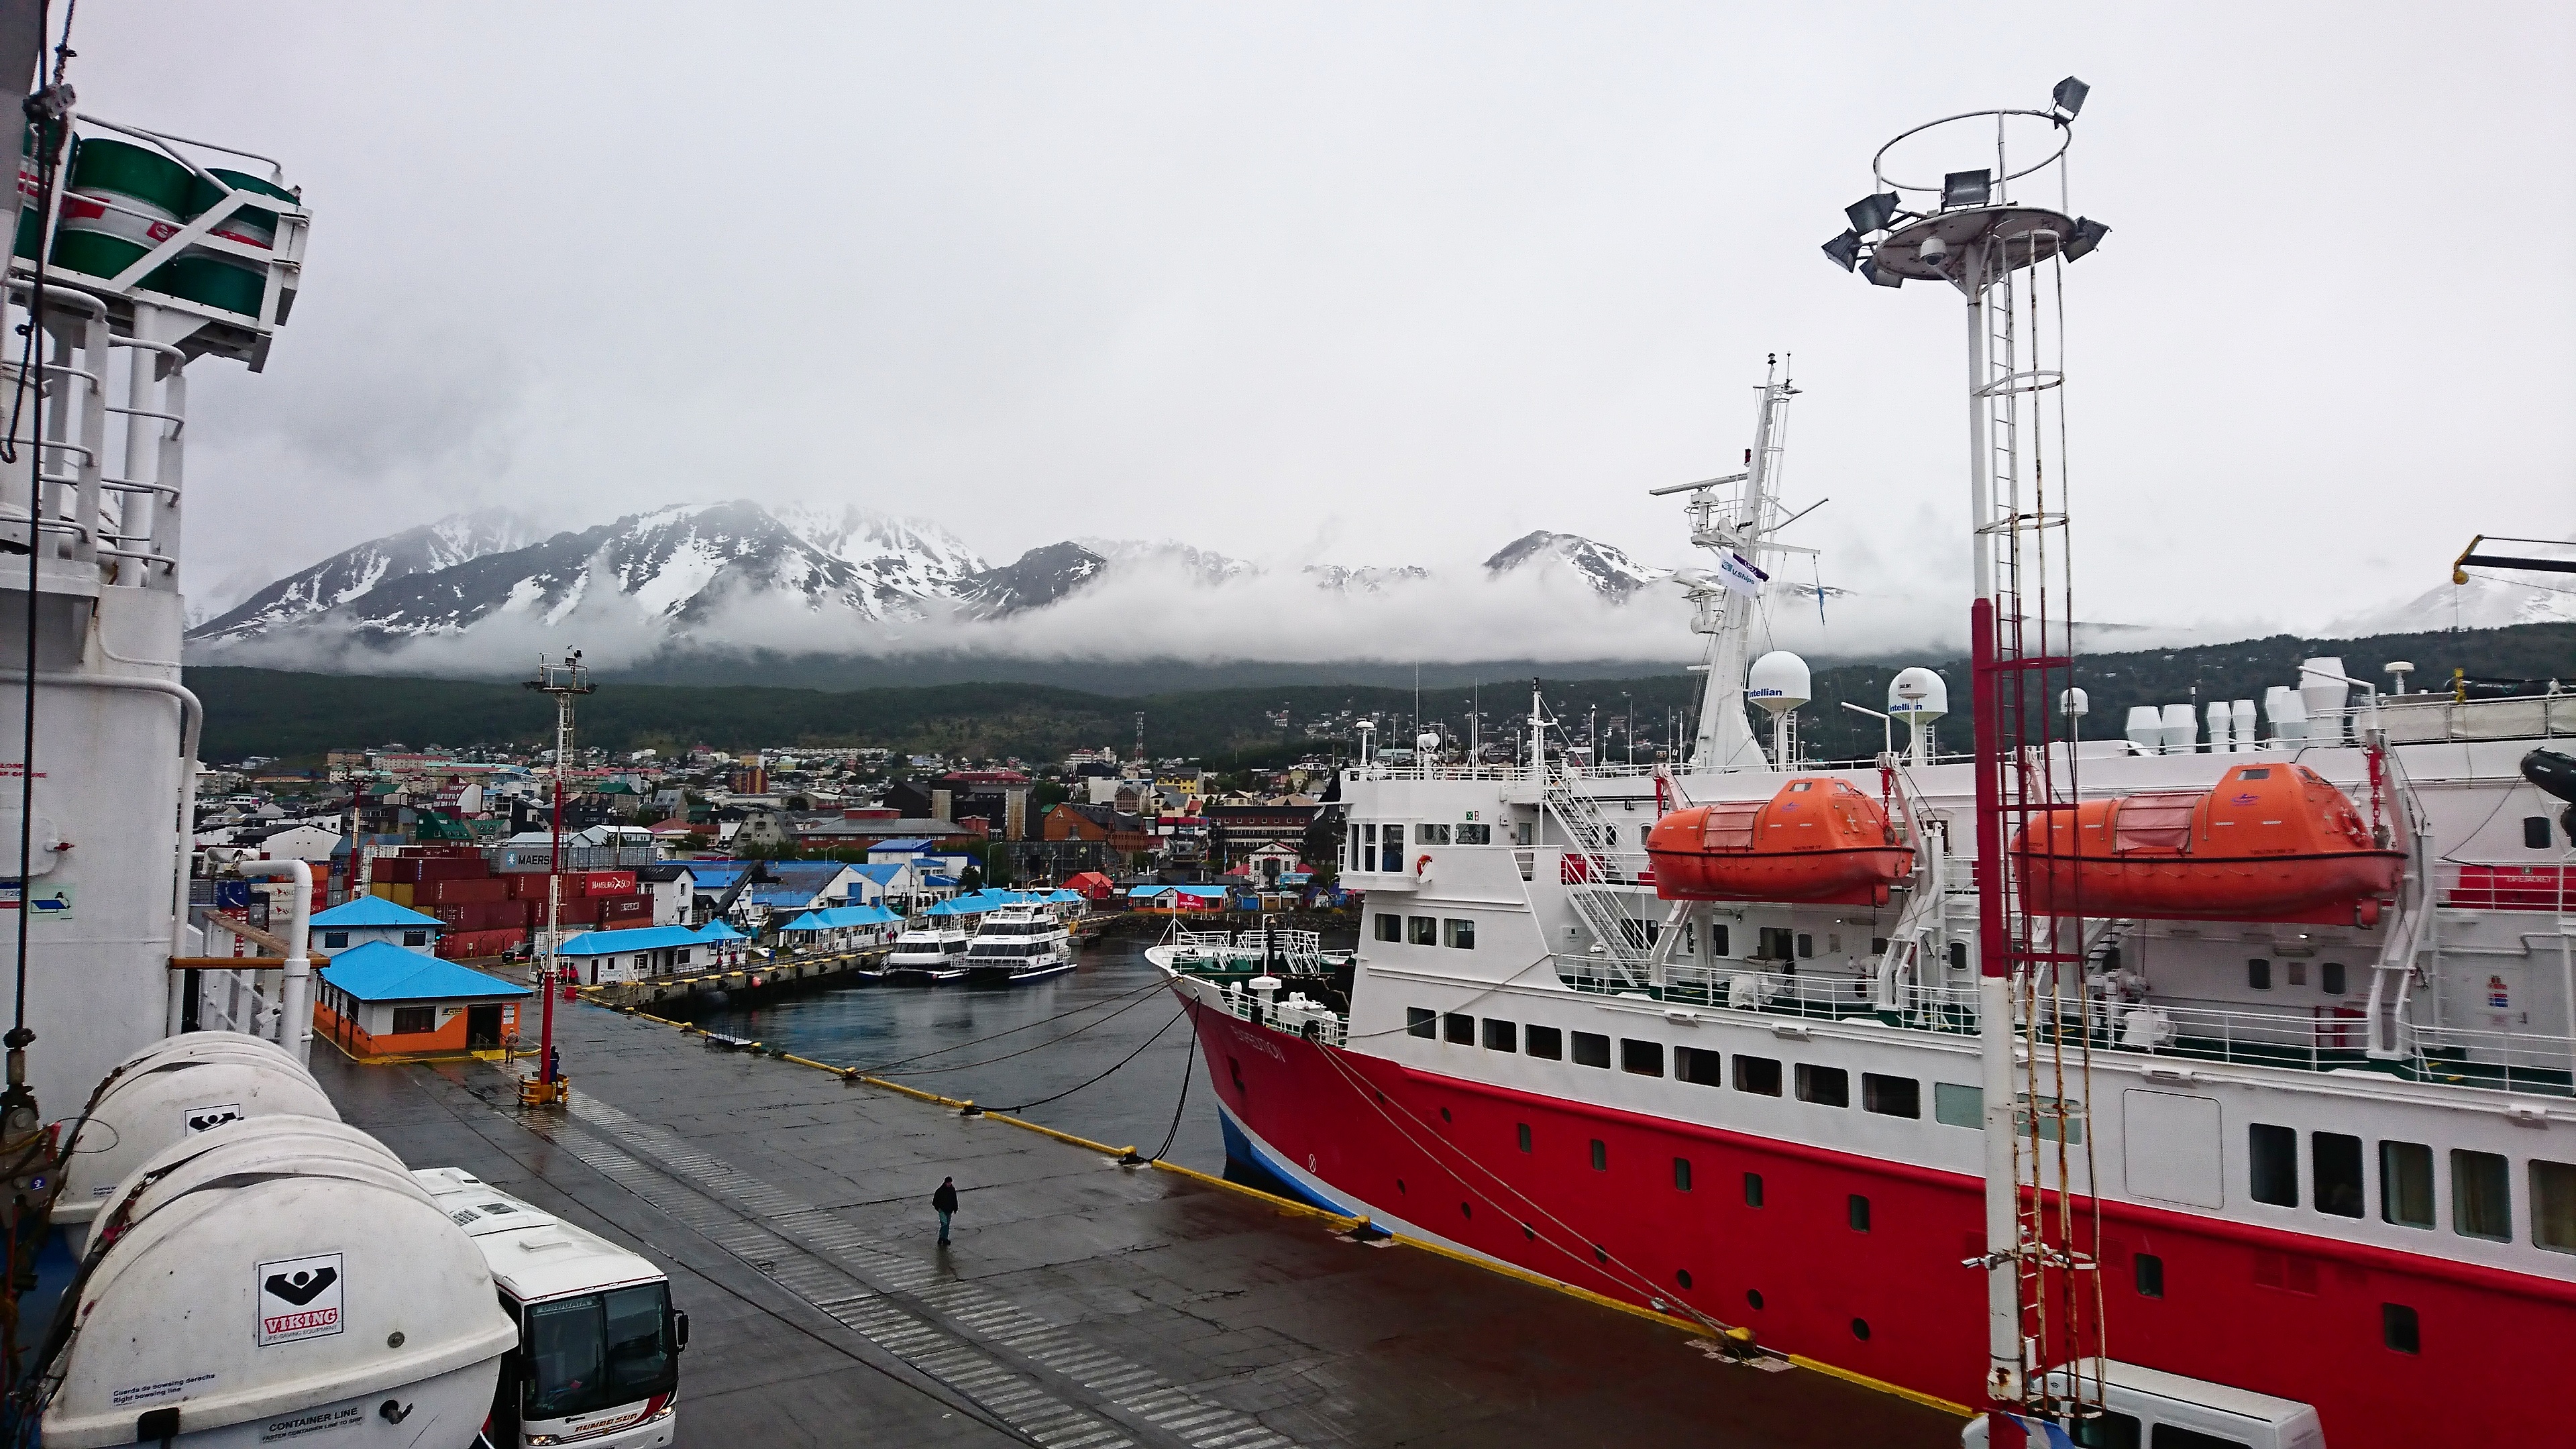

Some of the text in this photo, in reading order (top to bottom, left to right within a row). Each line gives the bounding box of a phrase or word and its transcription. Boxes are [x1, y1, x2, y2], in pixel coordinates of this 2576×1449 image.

[1732, 568, 1755, 584] V.Ships
[1749, 688, 1782, 698] Intellian
[1890, 703, 1923, 712] Intellin
[592, 880, 614, 890] HAMBURG
[1230, 1025, 1286, 1063] EXPEDITION
[264, 1308, 338, 1334] VIKING
[265, 1324, 338, 1342] LIFE-SAVING EQUIPMENT
[152, 1379, 184, 1390] bowsing
[113, 1395, 133, 1403] Right
[134, 1389, 166, 1400] bowsing
[269, 1407, 358, 1433] CONTAINER LINE
[574, 1413, 638, 1432] RUMBO SUR
[262, 1432, 286, 1442] FASTEN
[287, 1425, 323, 1437] CONTAINER
[324, 1421, 339, 1430] LINE
[349, 1416, 363, 1424] SHIP
